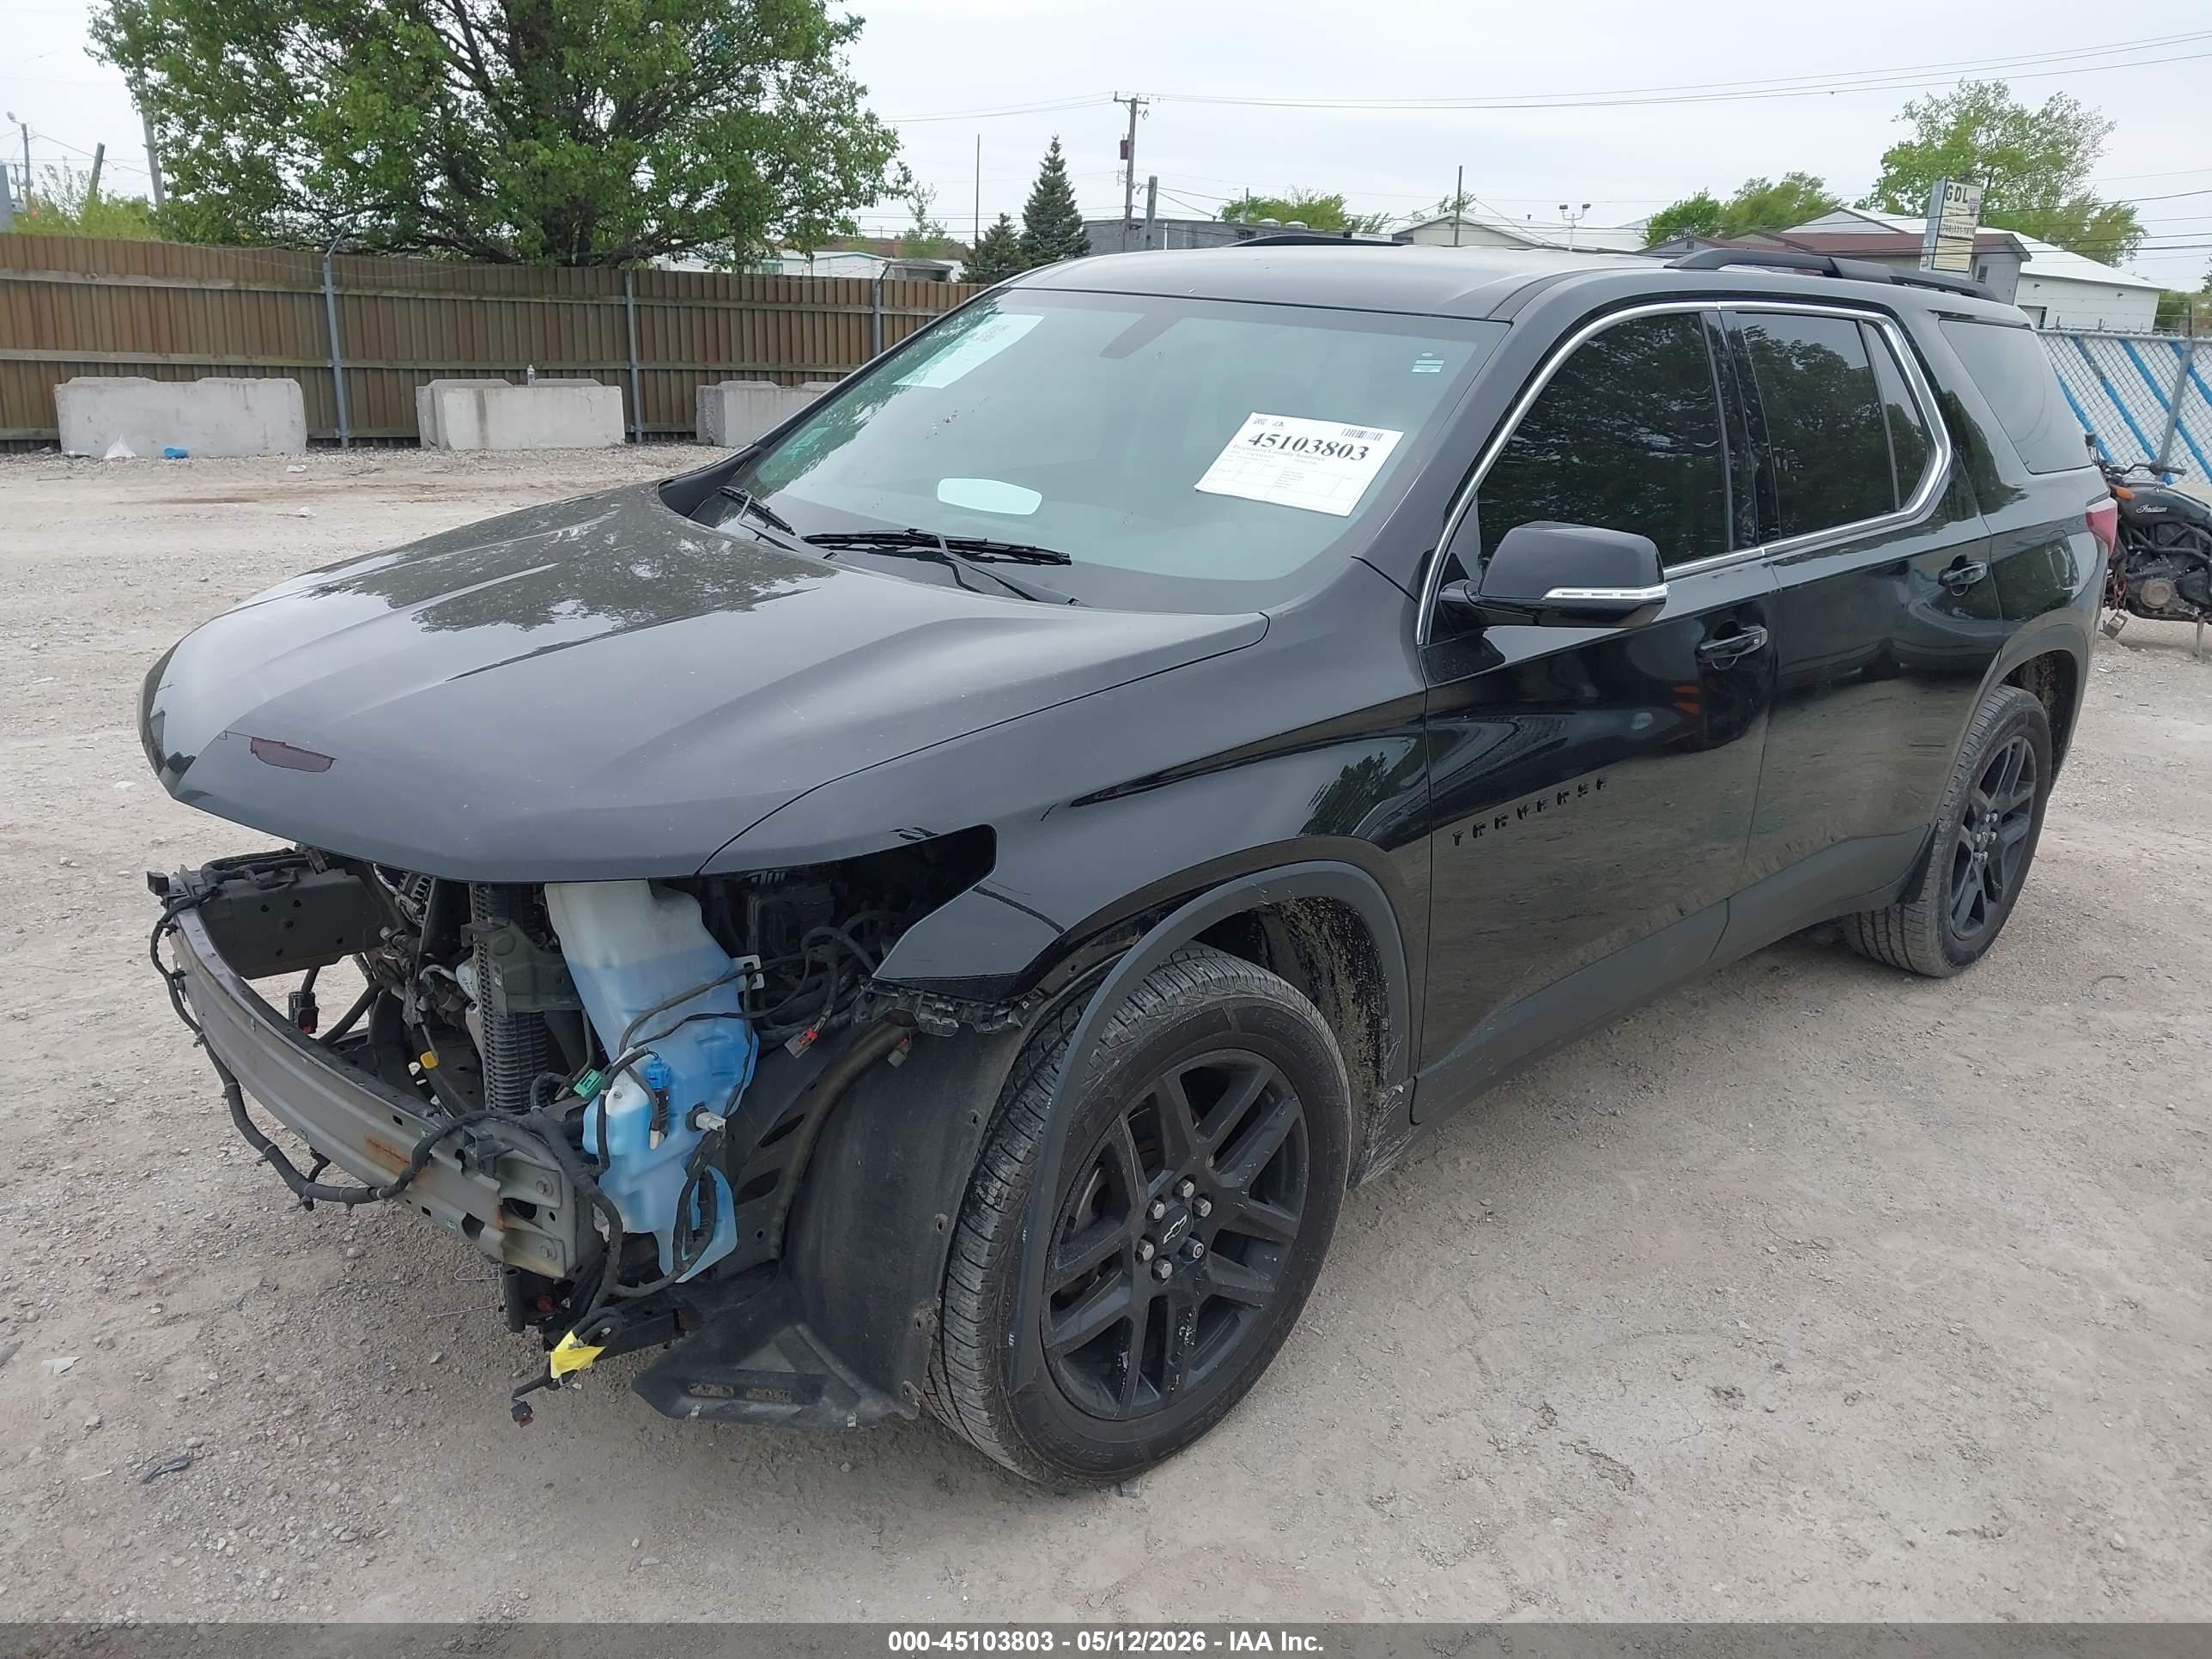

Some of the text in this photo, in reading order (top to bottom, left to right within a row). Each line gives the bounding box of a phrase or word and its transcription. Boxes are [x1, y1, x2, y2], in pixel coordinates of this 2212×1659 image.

[1945, 184, 1968, 204] GDL
[1248, 432, 1370, 461] 45103803
[2136, 504, 2169, 514] Indian
[1451, 776, 1608, 846] TRAVERSE
